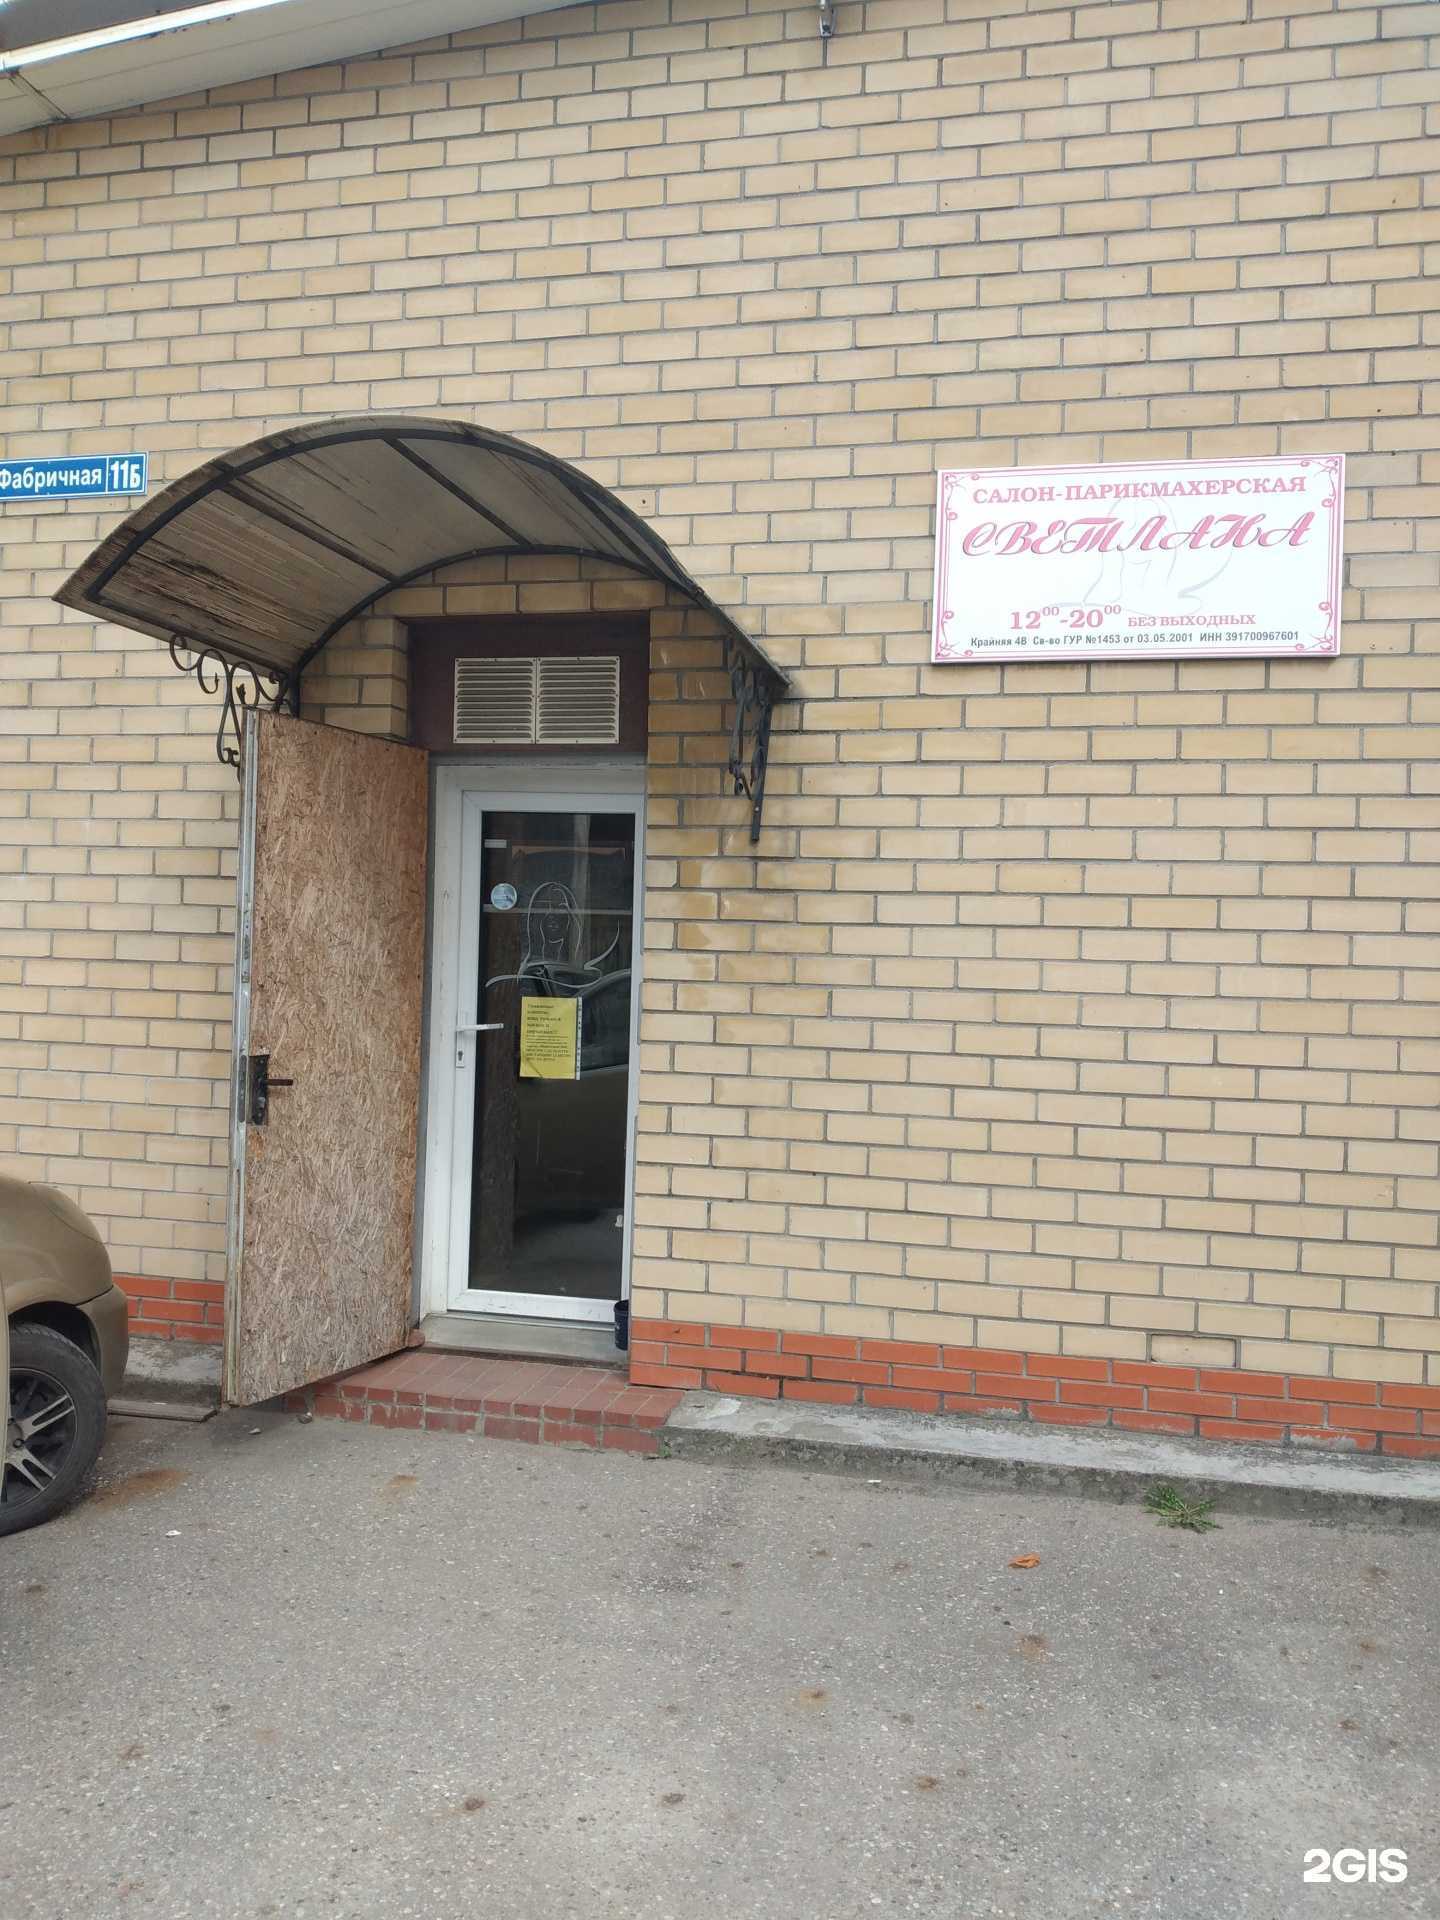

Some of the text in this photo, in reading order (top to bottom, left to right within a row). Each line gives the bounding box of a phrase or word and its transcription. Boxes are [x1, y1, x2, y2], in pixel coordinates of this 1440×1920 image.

[0, 460, 141, 493] Фабричная 11Б
[973, 476, 1306, 504] САЛОН-ПАРИКМАХЕРСКАЯ
[962, 511, 1316, 556] СВЕТЛАНА
[1127, 616, 1157, 627] БЕЗ
[1160, 614, 1257, 628] ВЫХОДНЫХ
[970, 637, 1012, 649] Крайняя
[1033, 635, 1060, 646] Св-во
[1063, 634, 1082, 645] ГУР
[1123, 636, 1134, 644] от
[1137, 633, 1193, 643] 03.05.2001
[1199, 632, 1223, 642] ИНН
[1225, 631, 1299, 642] 391700967601
